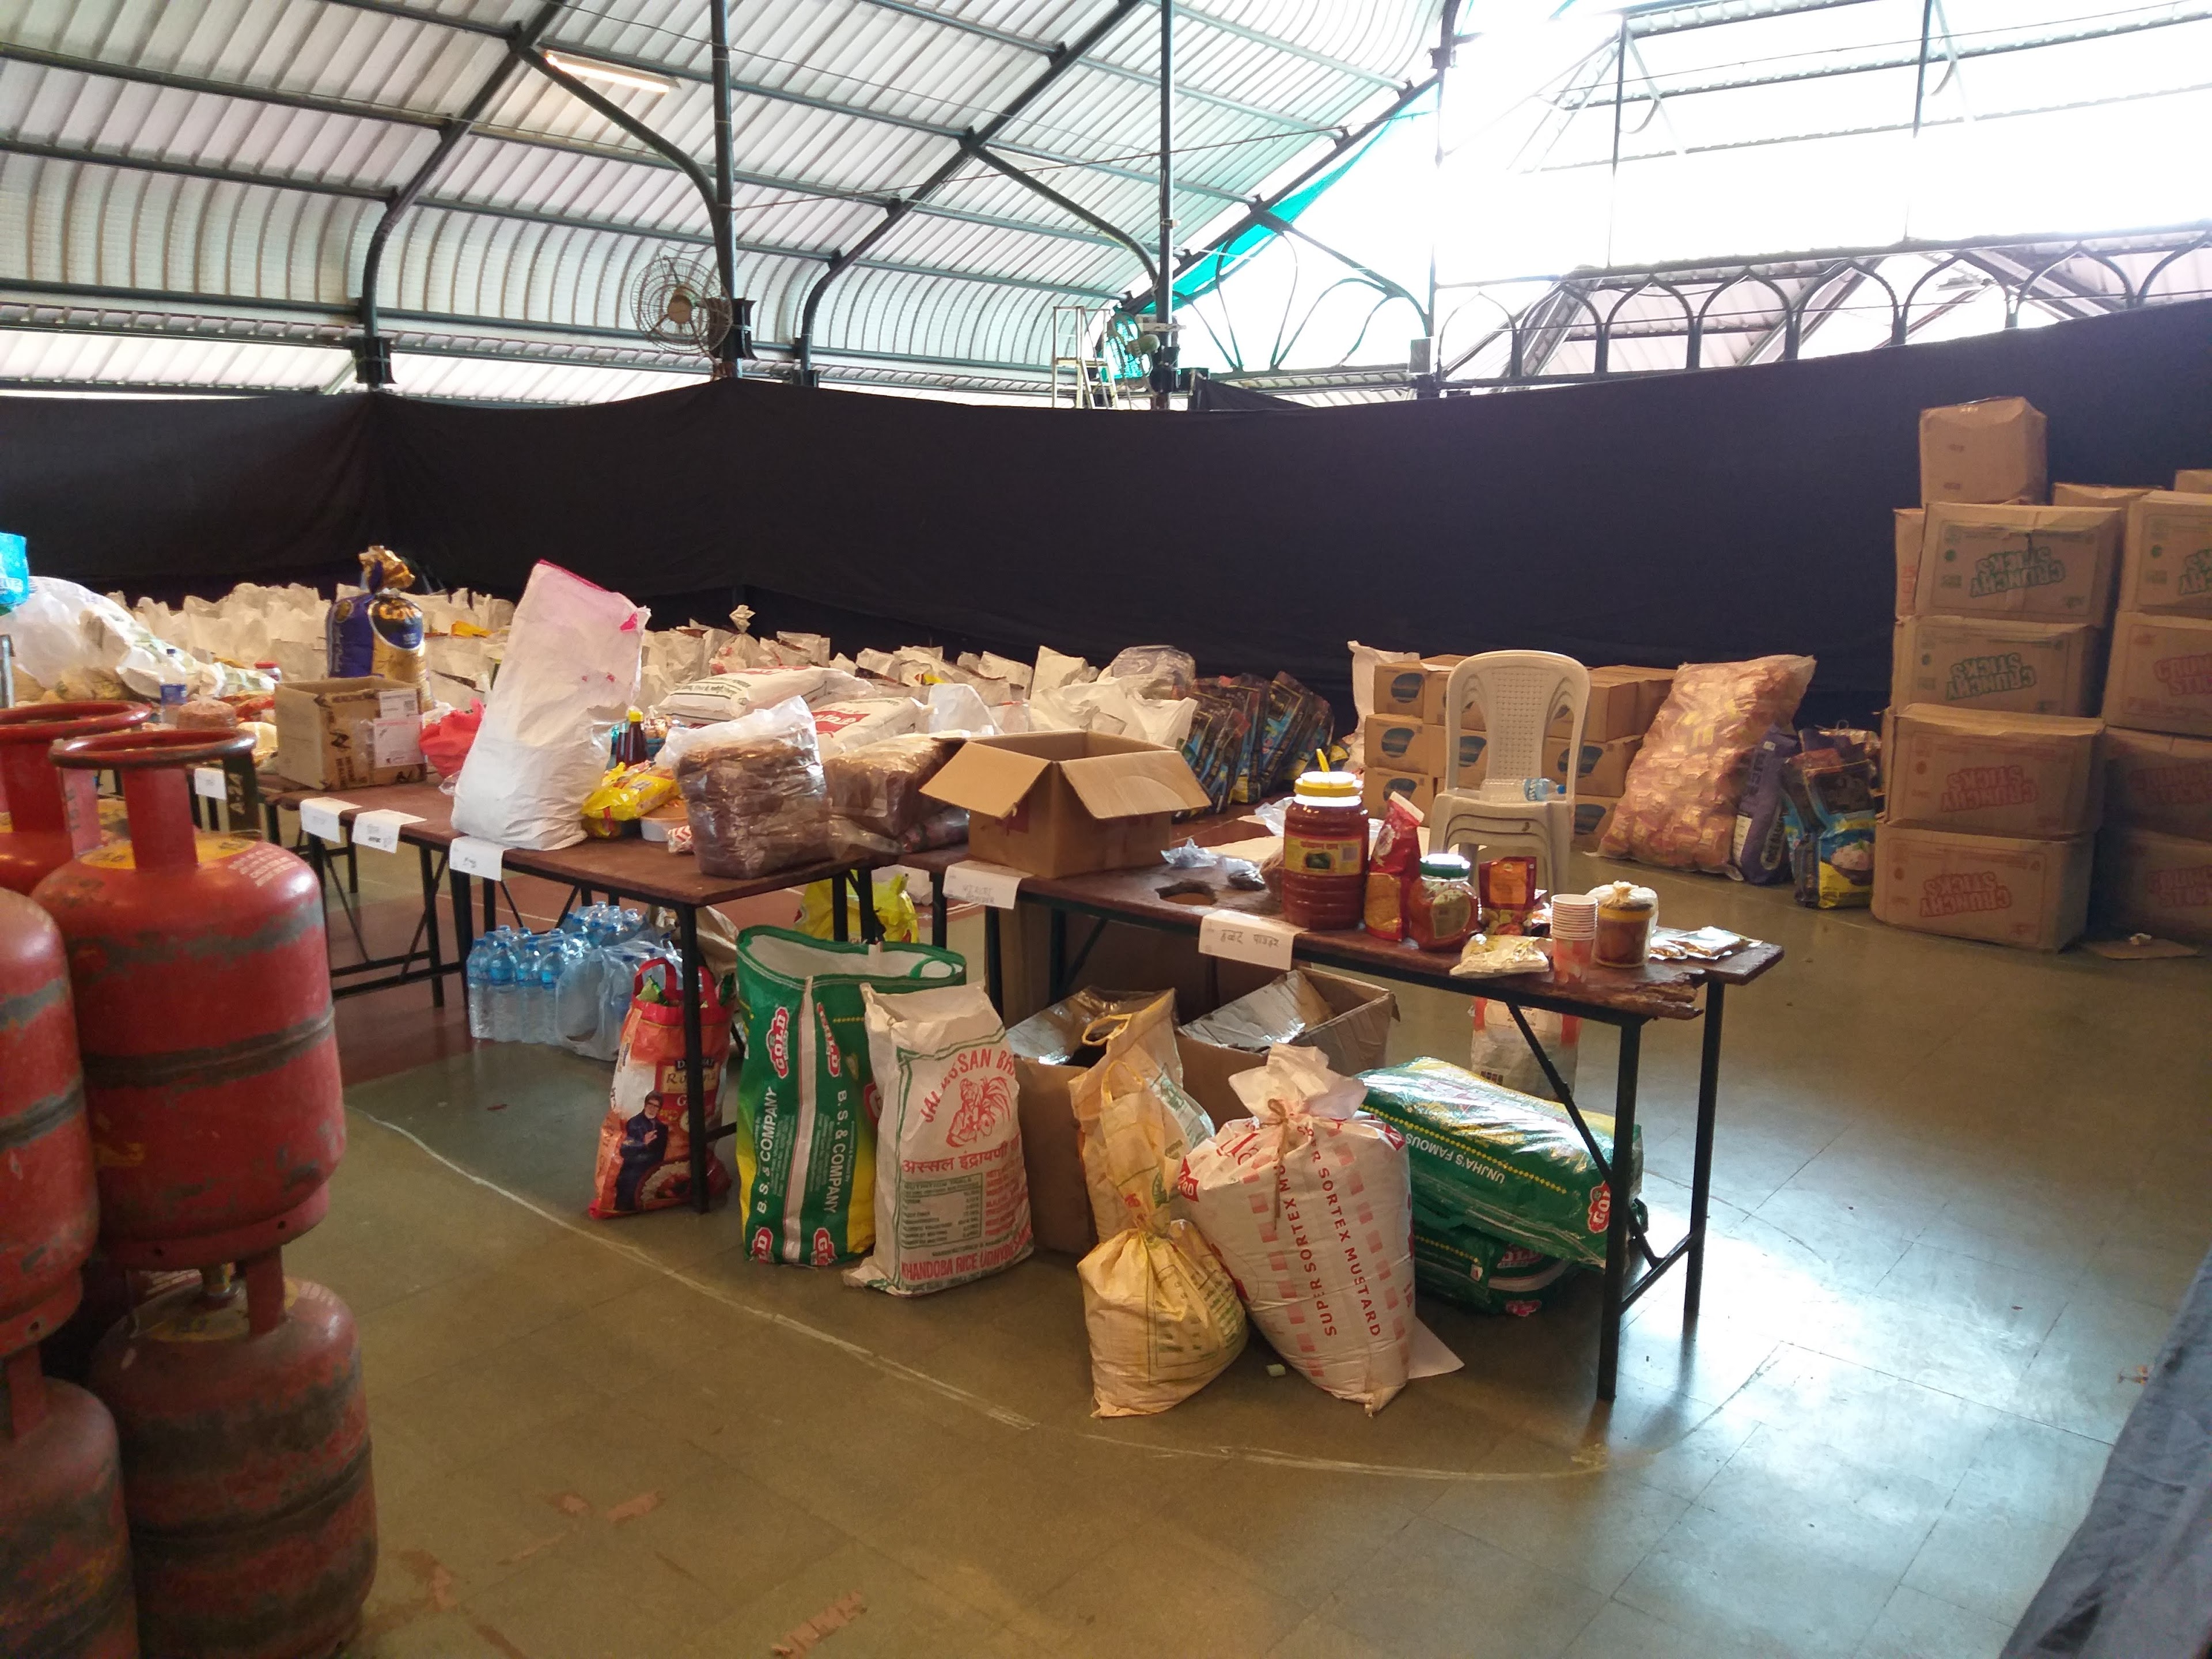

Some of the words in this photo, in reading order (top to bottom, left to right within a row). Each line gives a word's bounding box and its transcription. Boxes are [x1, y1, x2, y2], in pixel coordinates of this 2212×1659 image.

[1970, 559, 2066, 598] CRUNCHY
[1950, 652, 2022, 680] STICKS
[1946, 665, 2036, 701] CRUNCHY
[1946, 764, 2024, 791] STICKS
[1940, 778, 2039, 813] CRUNCHY
[1924, 871, 1998, 896] STICKS
[1919, 884, 2013, 918] CRUNCHY
[837, 1089, 848, 1108] B.
[921, 1090, 941, 1123] JAI
[760, 1086, 779, 1162] COMPANY
[836, 1109, 849, 1126] S.
[835, 1128, 849, 1141] &
[1405, 1132, 1452, 1162] FAMOUS
[823, 1145, 845, 1214] COMPANY
[902, 1156, 955, 1175] अस्सल
[1455, 1155, 1506, 1185] UNJHA'S
[759, 1179, 770, 1196] S.
[756, 1199, 767, 1214] B.
[1285, 1198, 1317, 1272] SORTEX
[956, 1252, 978, 1273] RICE
[1318, 1167, 1351, 1243] SORTEX
[1344, 1247, 1381, 1337] MUSTARD
[1309, 1277, 1338, 1337] SUPER
